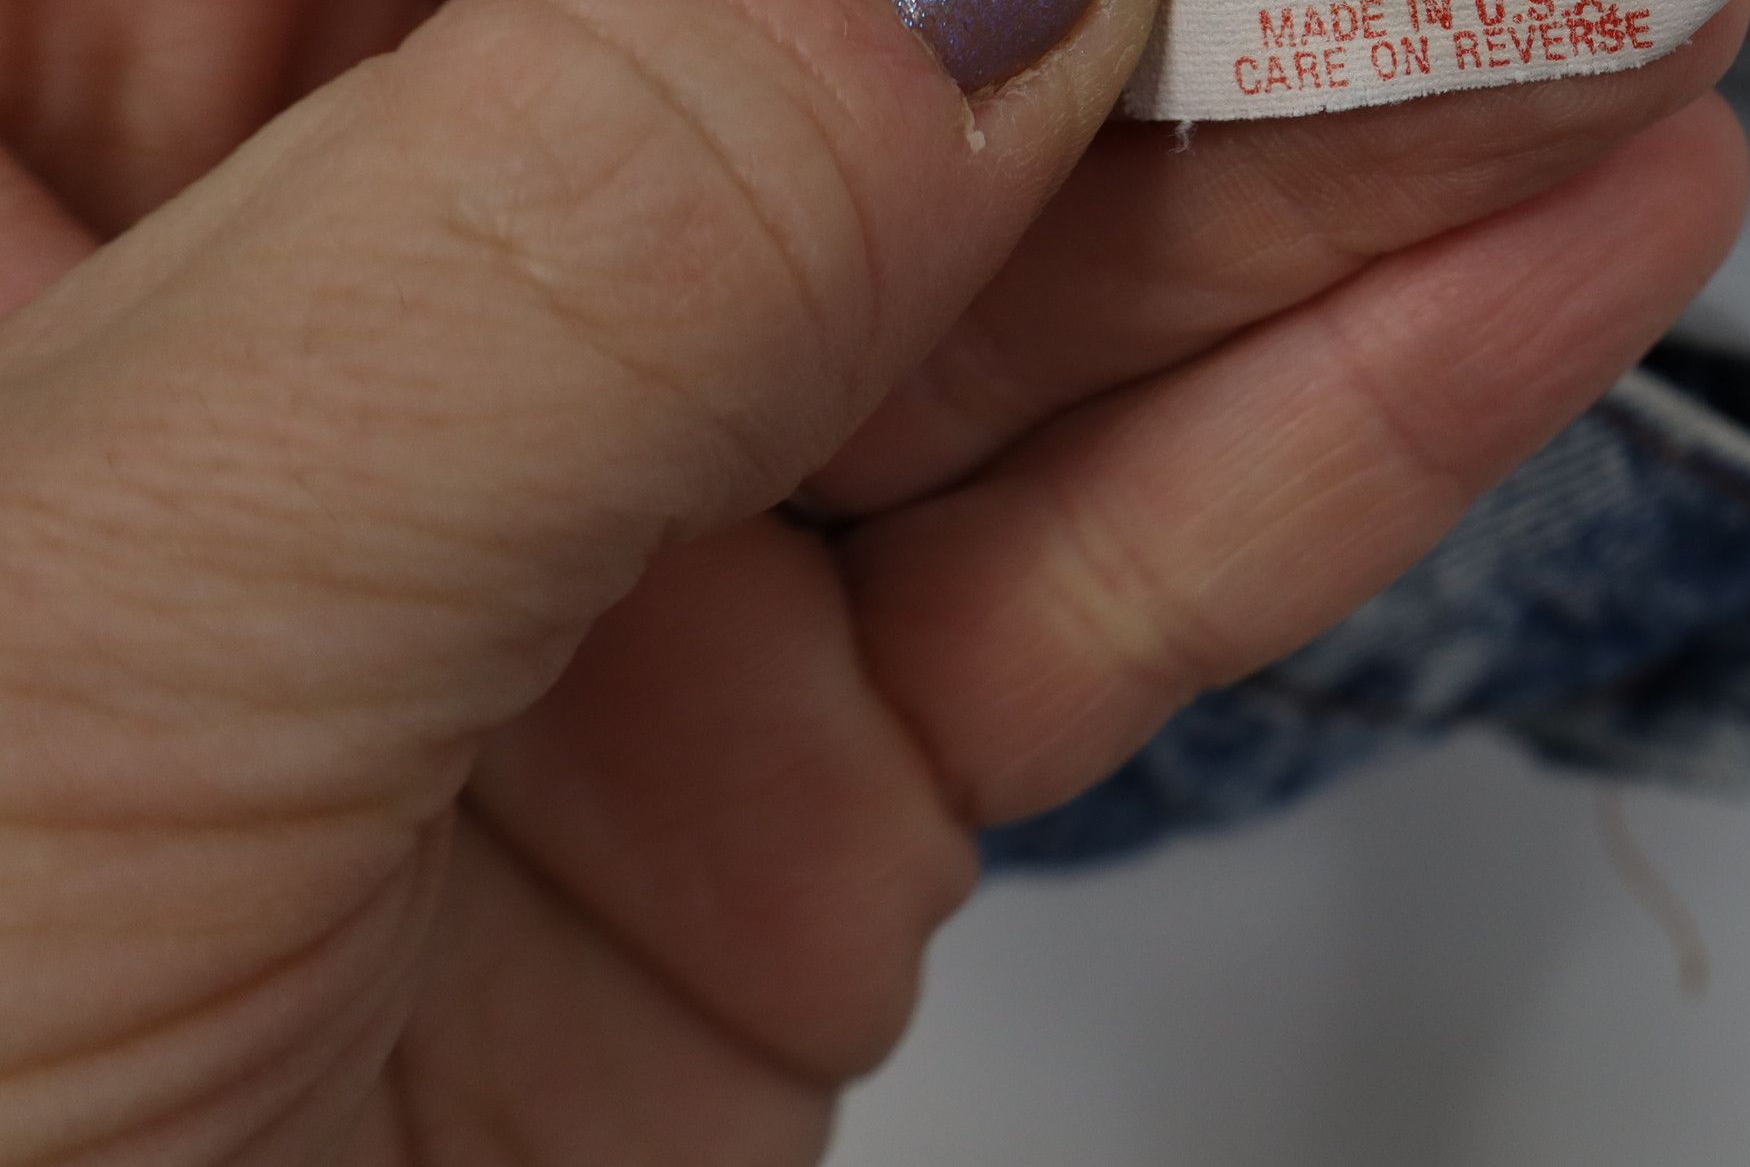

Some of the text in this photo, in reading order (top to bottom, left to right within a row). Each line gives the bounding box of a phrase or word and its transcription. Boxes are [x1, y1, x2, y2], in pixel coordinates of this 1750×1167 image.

[1233, 8, 1655, 96] CARE ON REVERSE
